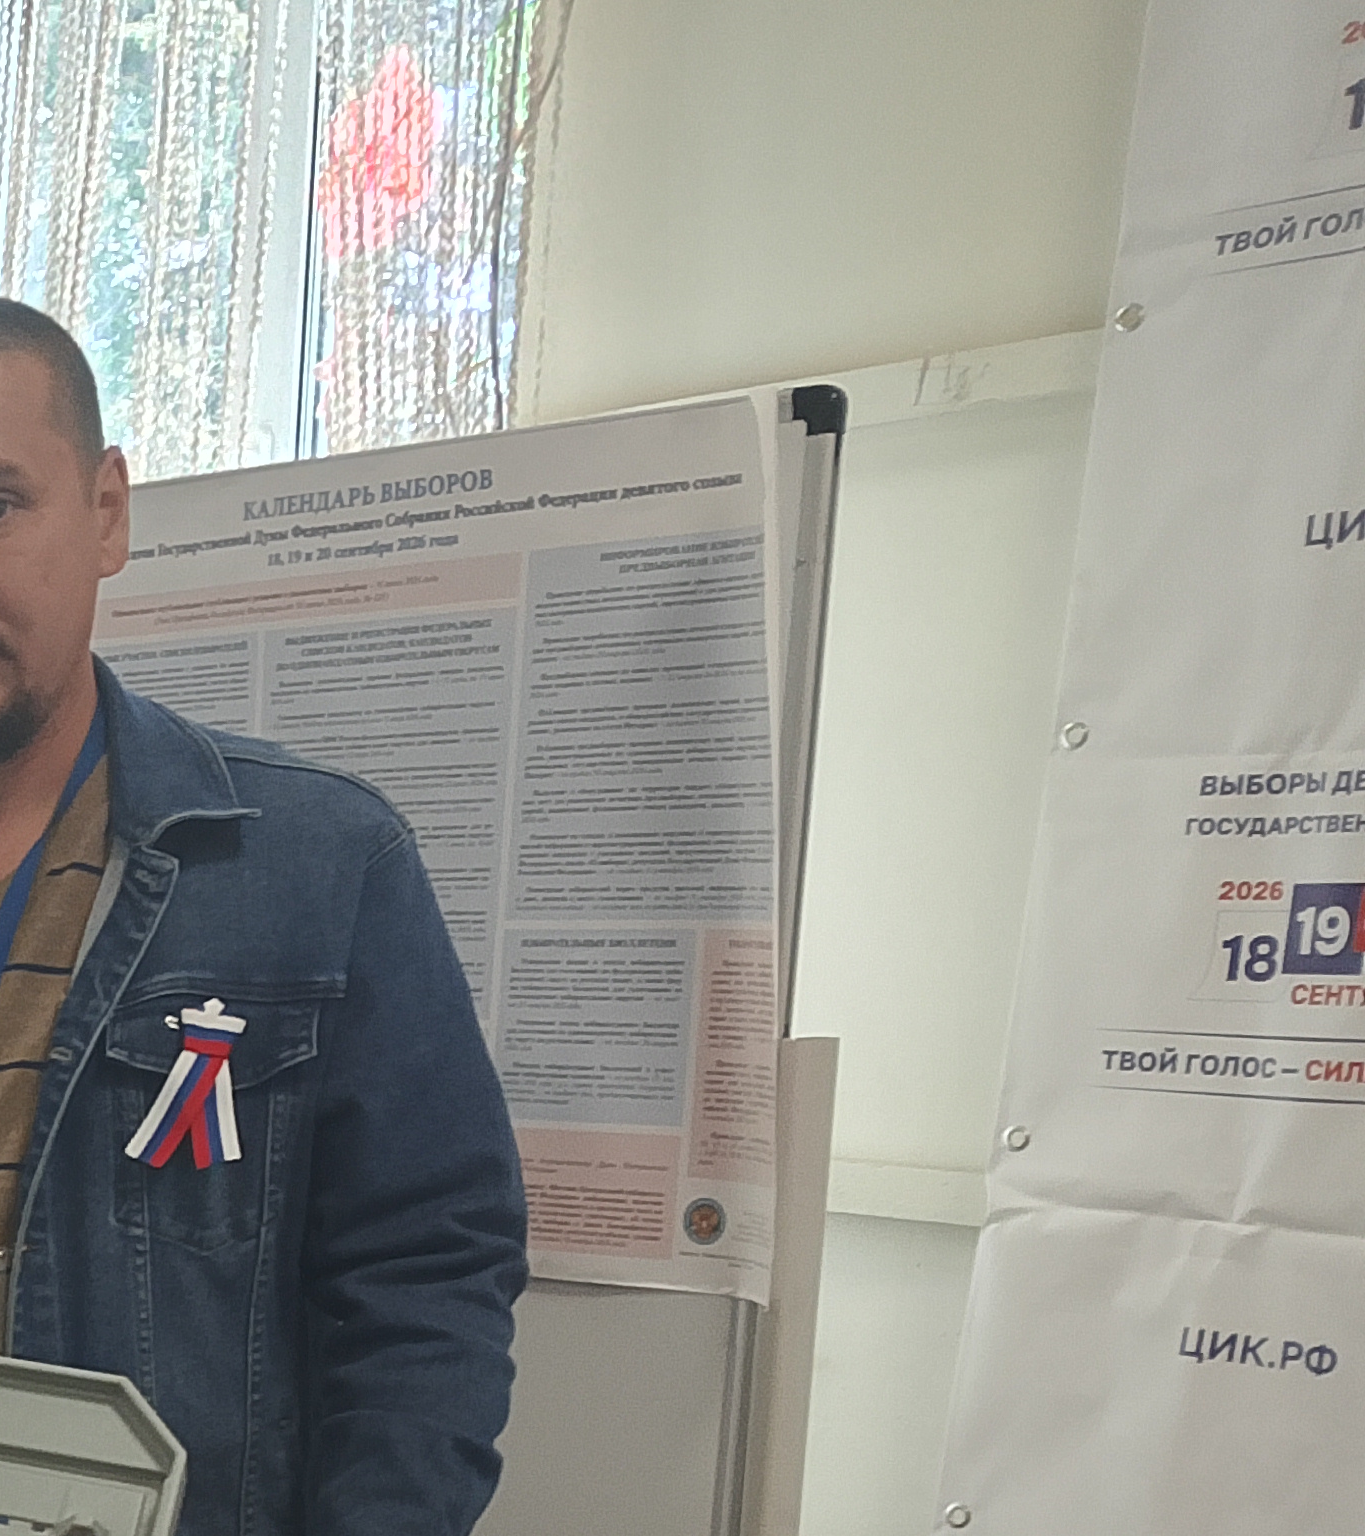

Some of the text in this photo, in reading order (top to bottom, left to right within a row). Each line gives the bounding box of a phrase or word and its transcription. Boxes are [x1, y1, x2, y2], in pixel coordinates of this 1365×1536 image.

[1342, 21, 1365, 44] 2
[1215, 207, 1365, 256] ТВОЙ ГОЛ
[243, 469, 494, 522] КАЛЕНДАРЬ ВЫБОРОВ
[1199, 771, 1327, 796] ВЫБОРЫ
[1218, 880, 1284, 901] 2026
[1221, 905, 1351, 982] 18 19
[1102, 1046, 1178, 1073] ТВОЙ
[1184, 1053, 1277, 1079] ГОЛОС
[1178, 1326, 1339, 1377] ЦИК.РФ
